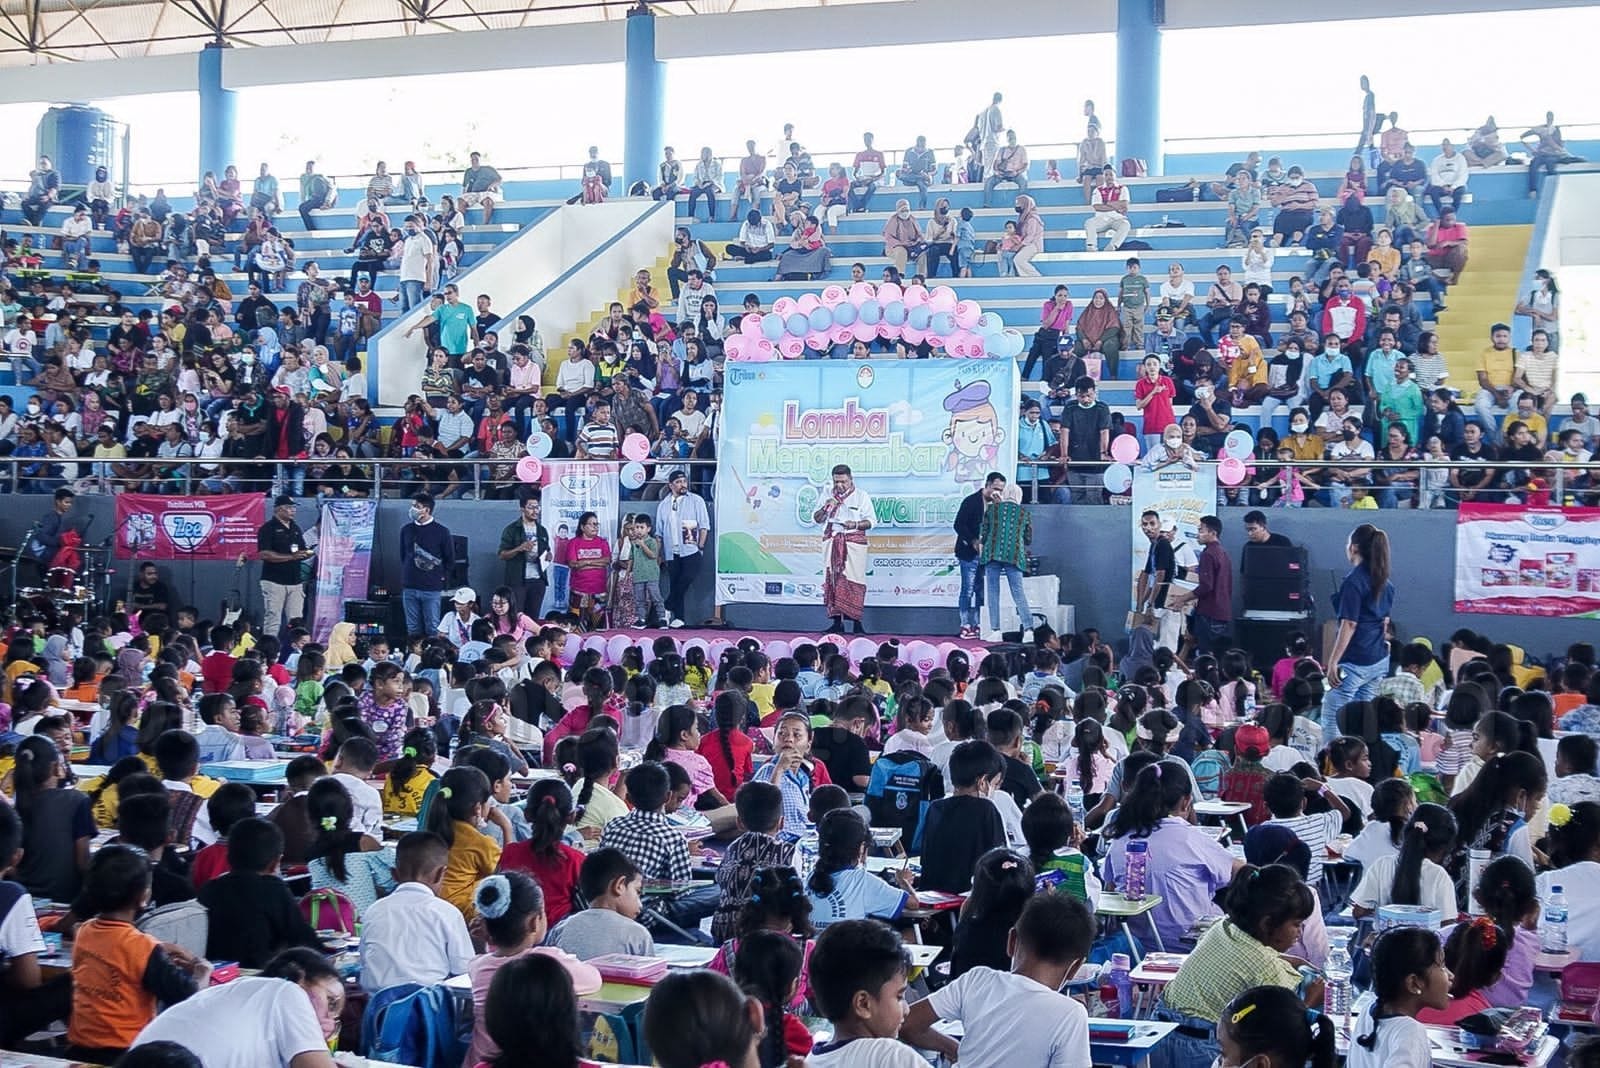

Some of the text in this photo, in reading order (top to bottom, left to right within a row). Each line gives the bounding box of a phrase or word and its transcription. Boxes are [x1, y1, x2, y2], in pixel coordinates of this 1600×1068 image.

[785, 400, 888, 440] Lomba
[749, 437, 947, 484] Menggambar
[173, 517, 202, 539] Zee
